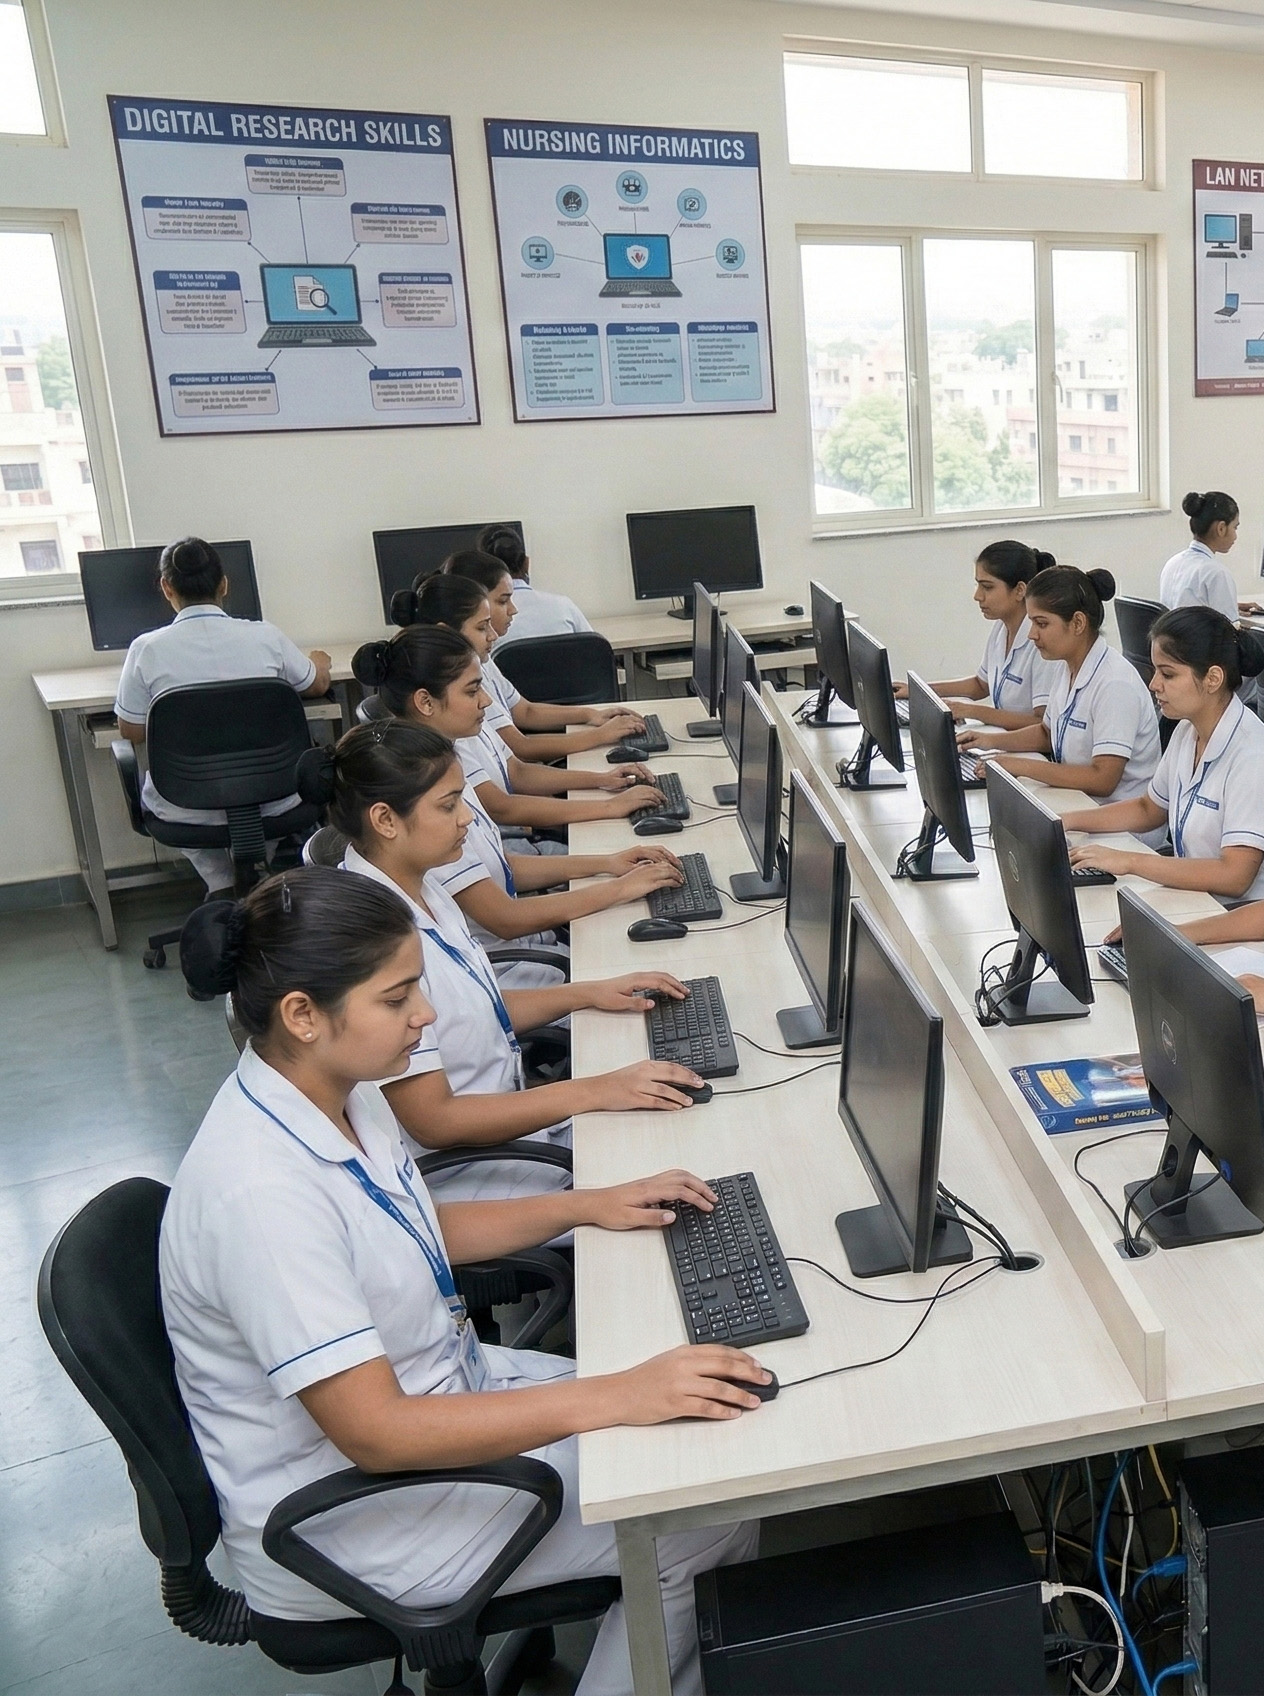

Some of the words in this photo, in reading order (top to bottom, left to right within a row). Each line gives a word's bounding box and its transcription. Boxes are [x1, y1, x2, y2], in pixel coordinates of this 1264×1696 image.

[123, 107, 224, 137] DIGITAL
[231, 113, 357, 143] RESEARCH
[364, 121, 442, 147] SKILLS
[503, 128, 601, 154] NURSING
[608, 133, 746, 160] INFORMATICS
[1206, 166, 1235, 186] LAN
